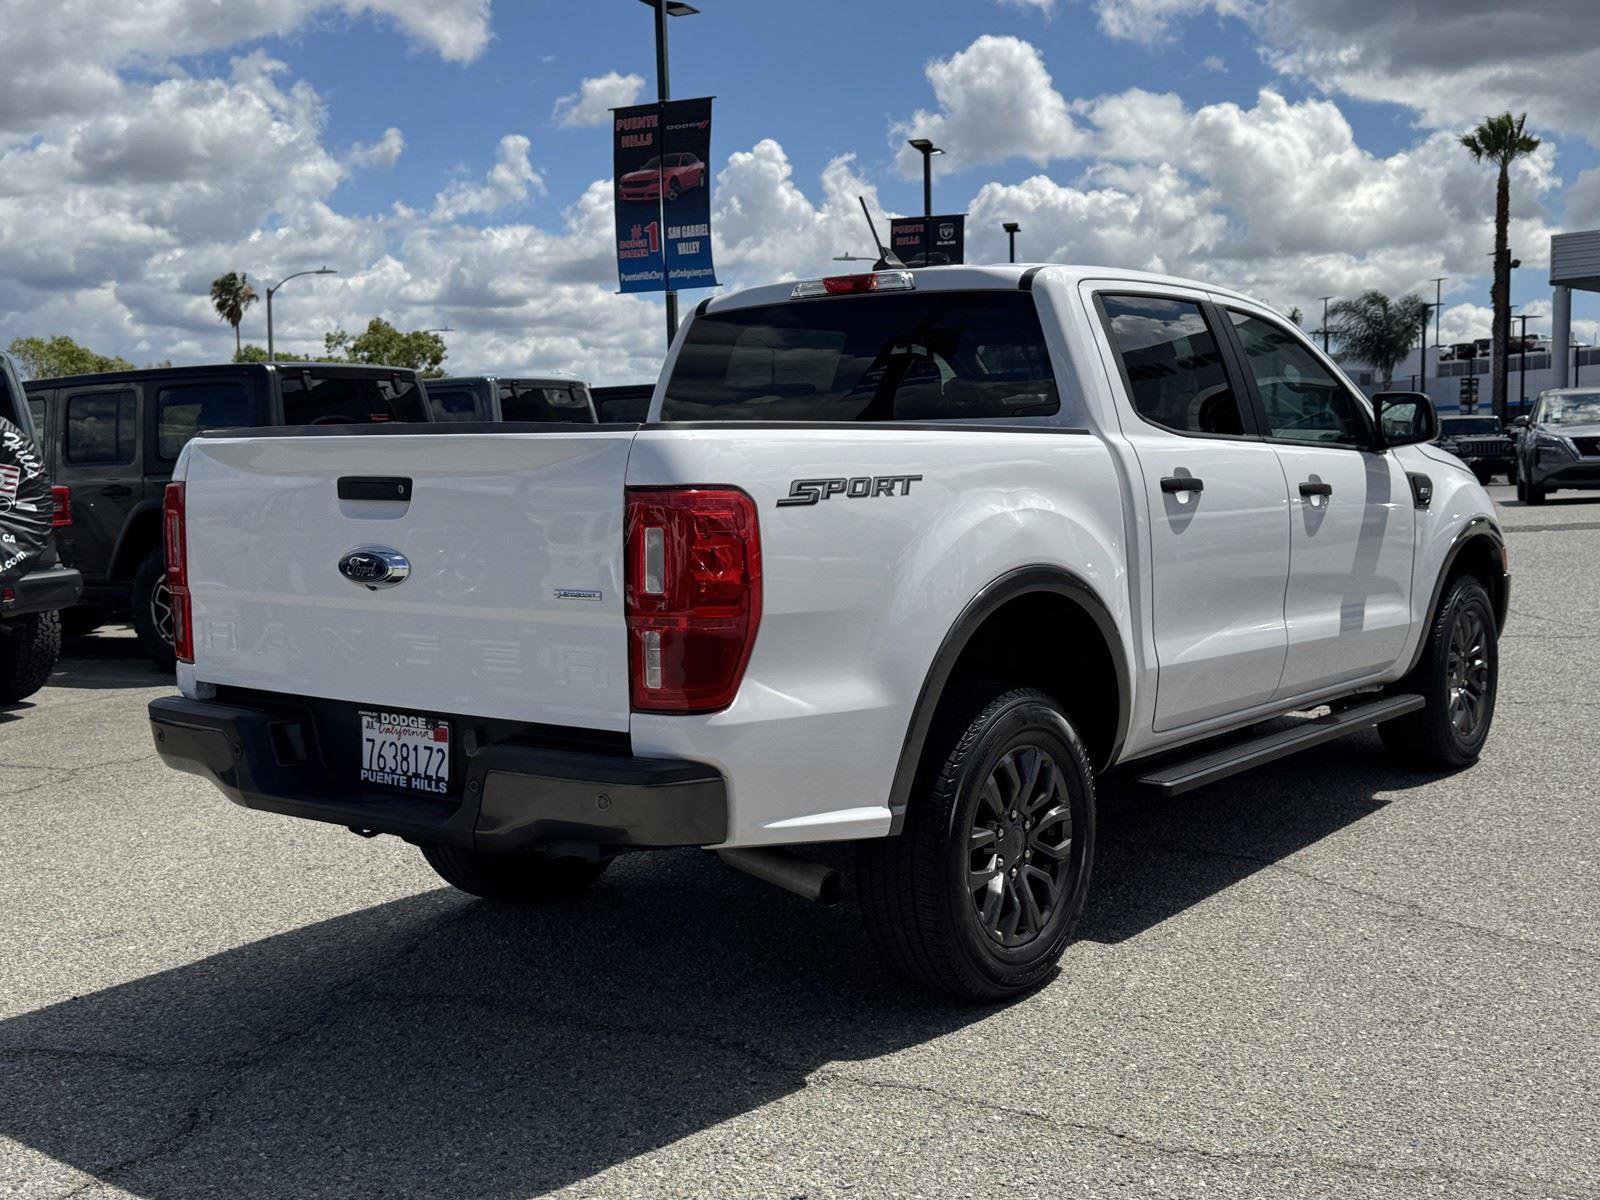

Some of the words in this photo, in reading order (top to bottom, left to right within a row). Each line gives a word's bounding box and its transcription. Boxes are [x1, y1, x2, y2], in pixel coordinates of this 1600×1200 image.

[616, 115, 658, 131] PUENTE
[621, 133, 653, 148] HILLS
[668, 226, 681, 239] SAN
[682, 224, 709, 238] GABRIEL
[677, 241, 700, 255] VALLEY
[776, 474, 923, 508] SPORT
[347, 556, 377, 578] Ford
[381, 713, 426, 729] DODGE
[361, 769, 407, 787] PUENTE
[412, 778, 447, 793] HILLS
